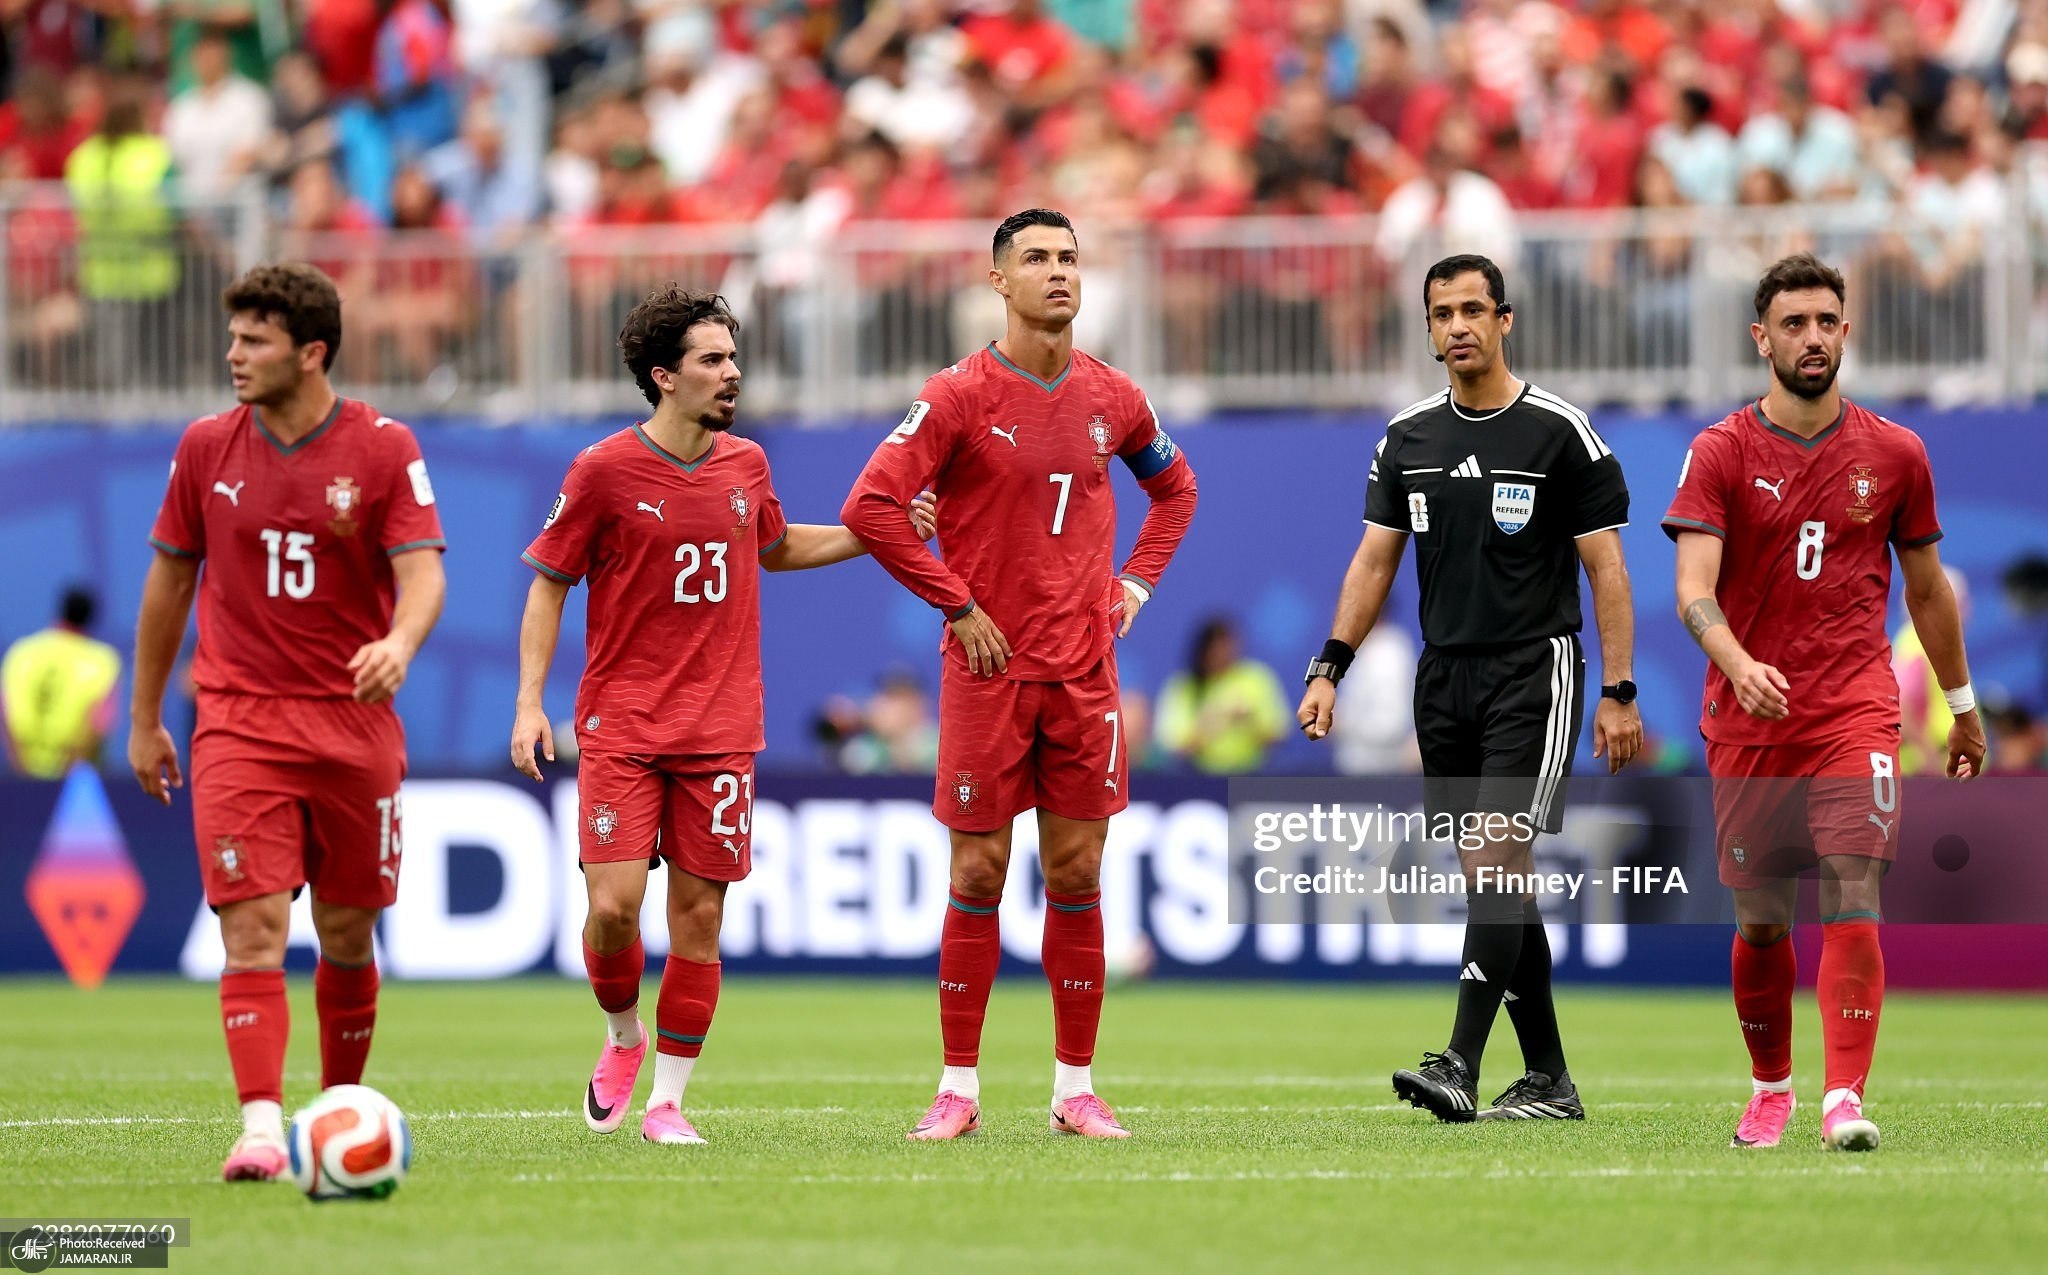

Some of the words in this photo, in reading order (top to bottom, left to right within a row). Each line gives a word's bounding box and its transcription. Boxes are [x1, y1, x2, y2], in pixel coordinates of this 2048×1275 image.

[1049, 473, 1074, 535] 7
[1495, 505, 1530, 516] REFEREE
[1497, 486, 1531, 501] FIFA
[260, 529, 315, 599] 15
[674, 541, 728, 604] 23
[1796, 520, 1826, 581] 8
[1104, 709, 1118, 773] 7
[711, 773, 751, 836] 23
[1869, 751, 1896, 813] 8
[376, 790, 402, 861] 15
